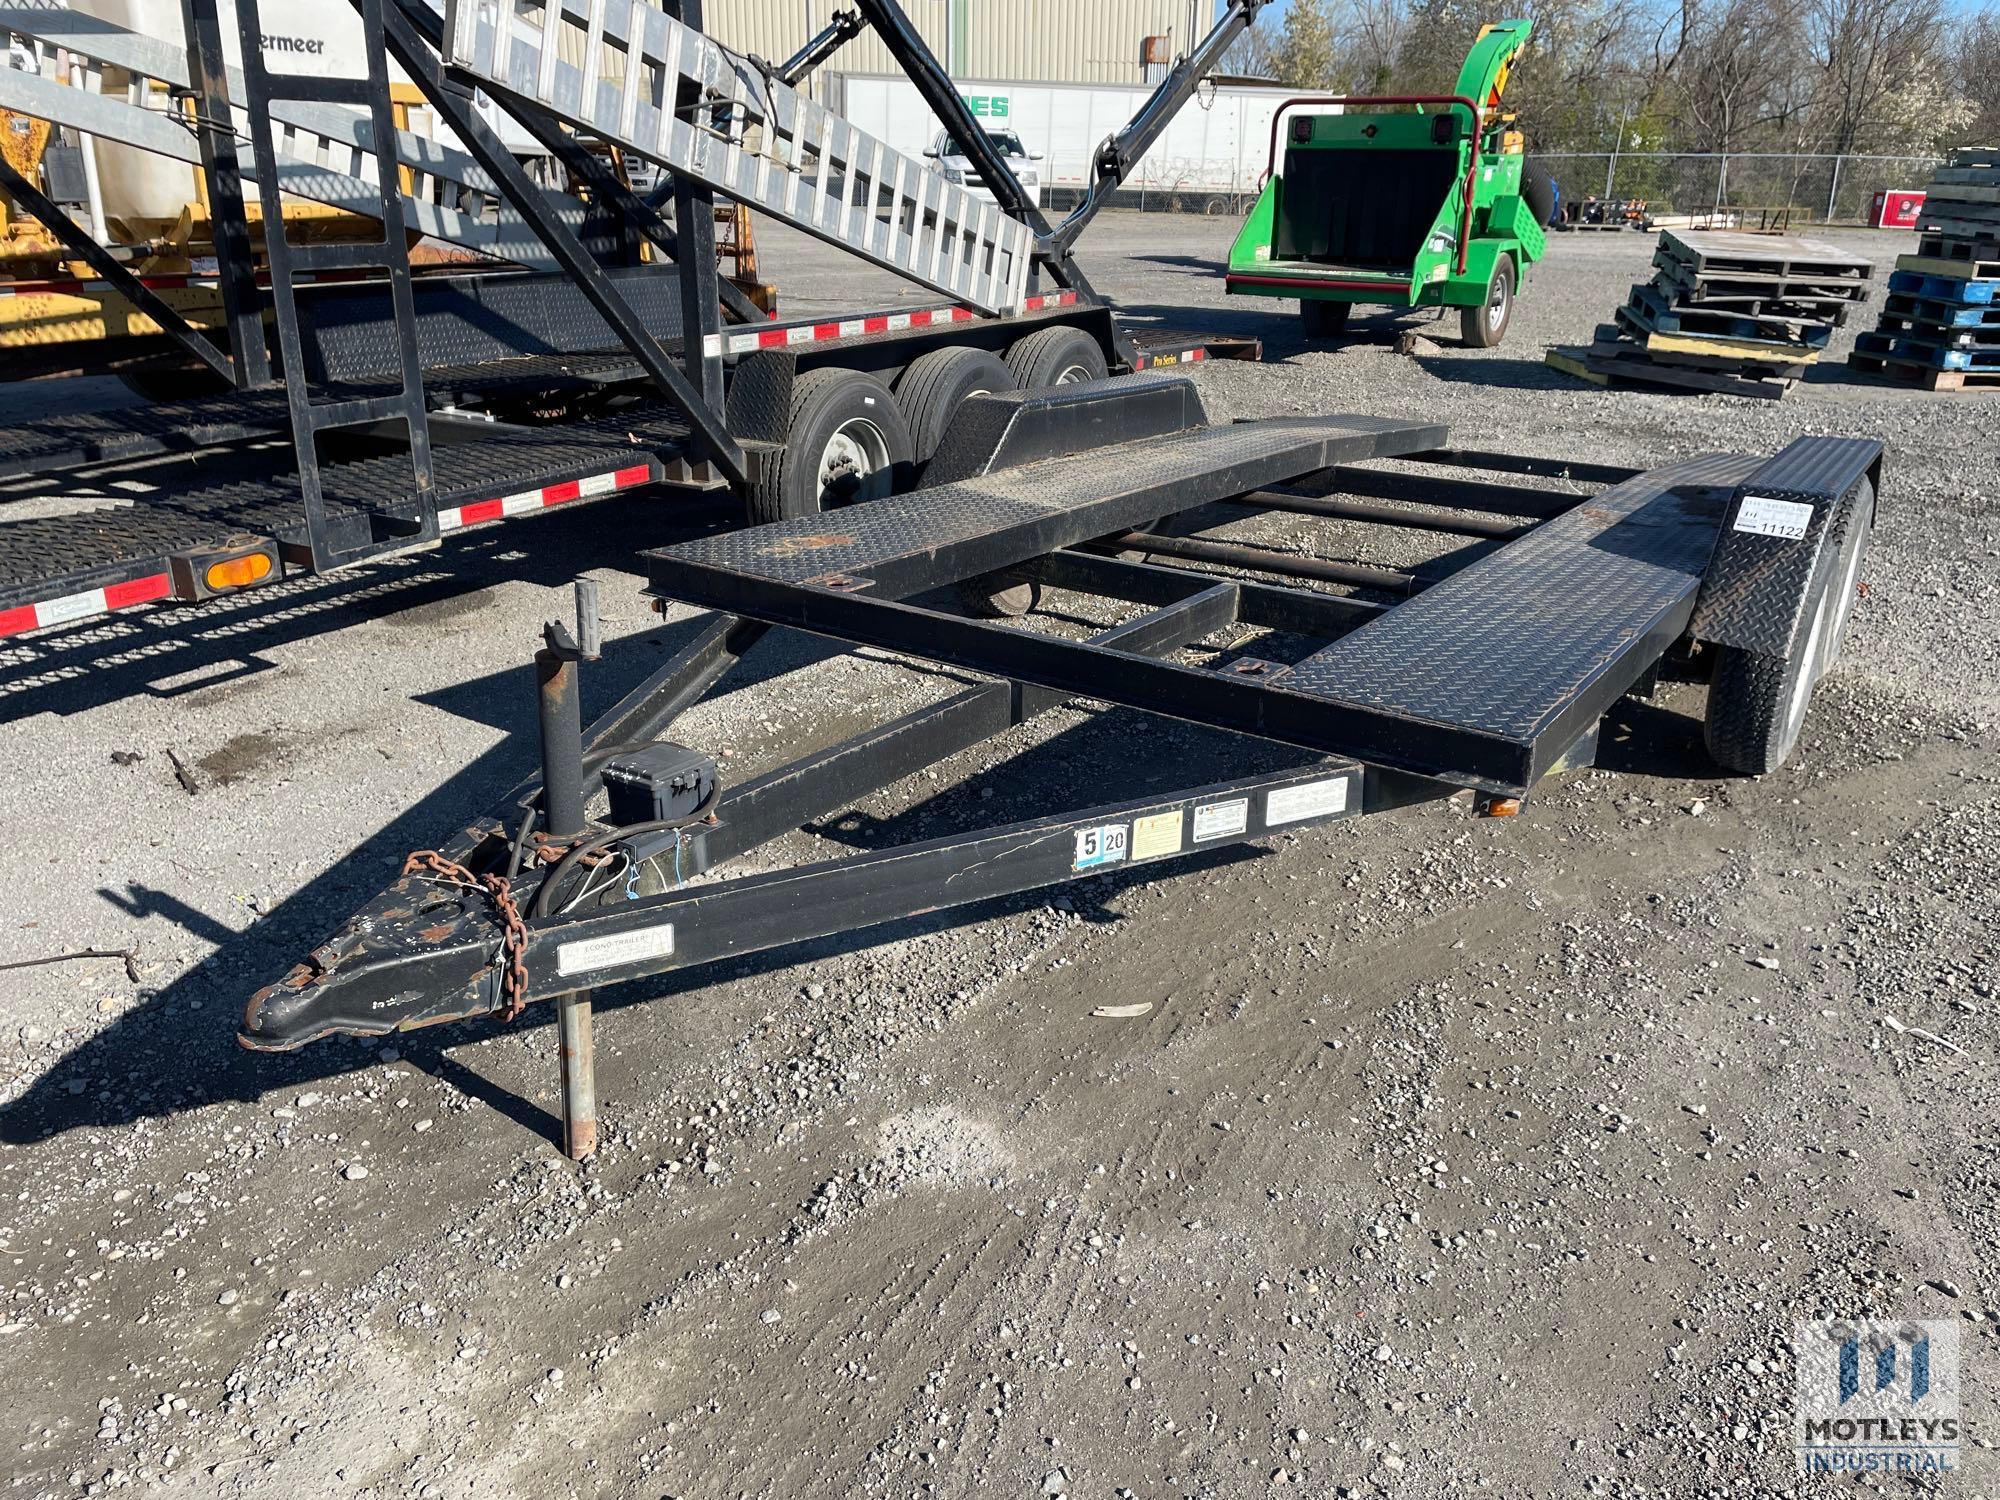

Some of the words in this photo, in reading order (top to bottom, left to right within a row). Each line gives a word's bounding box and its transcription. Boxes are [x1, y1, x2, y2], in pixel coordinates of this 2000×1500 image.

[961, 96, 1009, 116] ES
[1761, 523, 1804, 537] 11122
[1084, 831, 1097, 856] 5
[1105, 832, 1124, 851] 20
